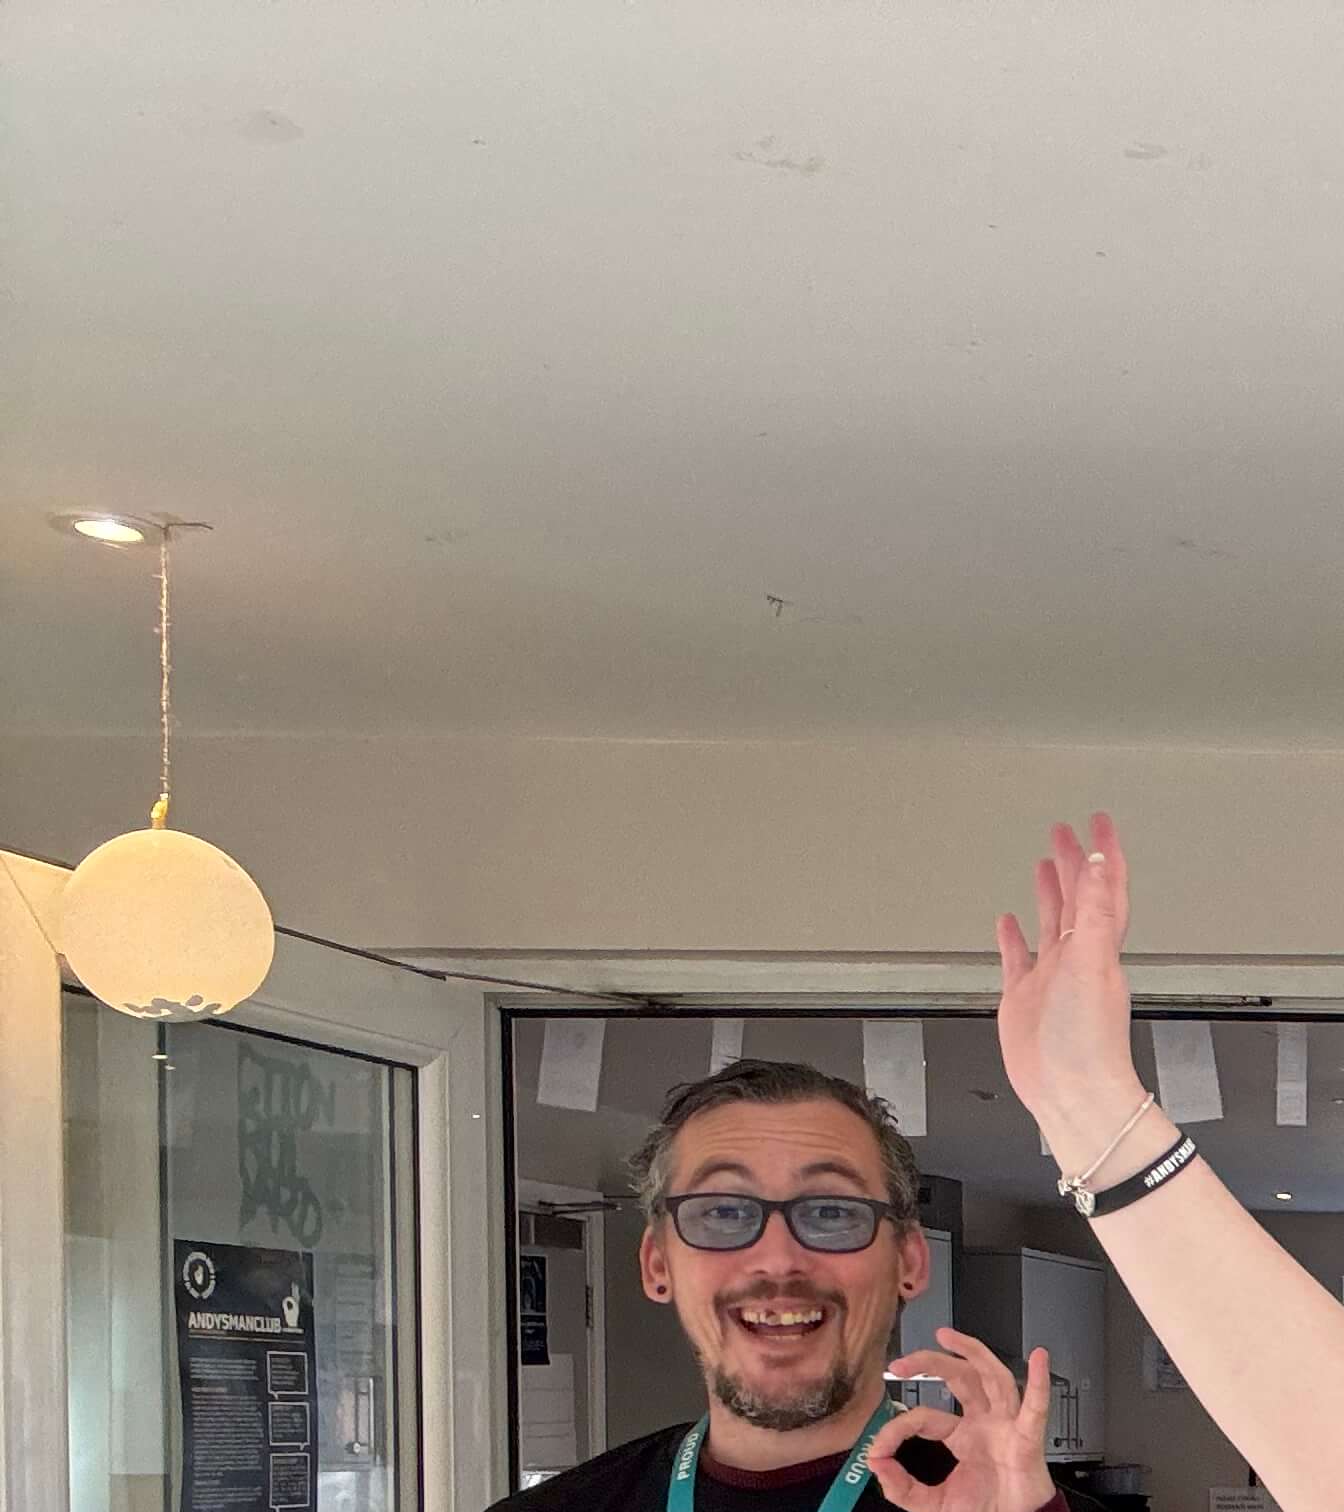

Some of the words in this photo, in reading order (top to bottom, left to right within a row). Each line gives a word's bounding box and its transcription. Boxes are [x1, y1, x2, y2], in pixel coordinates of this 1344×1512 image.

[188, 1311, 282, 1334] ANDYSMANCLUB
[676, 1433, 699, 1481] PROUD
[845, 1435, 875, 1484] OUD
